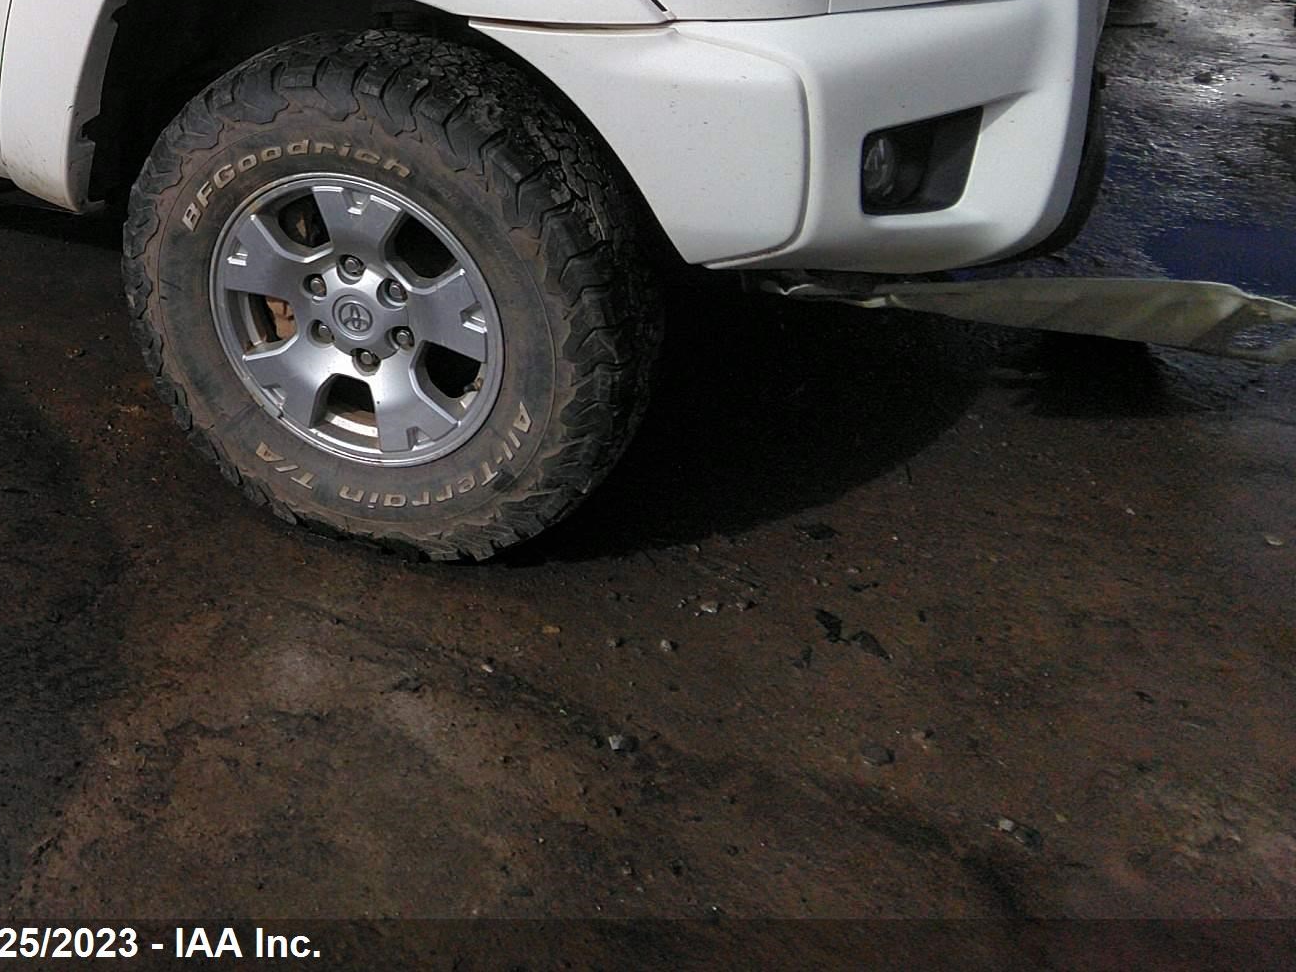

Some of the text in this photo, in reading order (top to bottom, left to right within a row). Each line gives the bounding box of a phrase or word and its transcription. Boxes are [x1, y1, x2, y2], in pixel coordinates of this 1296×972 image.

[182, 139, 412, 233] BFGoodrich
[255, 441, 314, 490] T/A
[338, 401, 533, 509] All-Terrain
